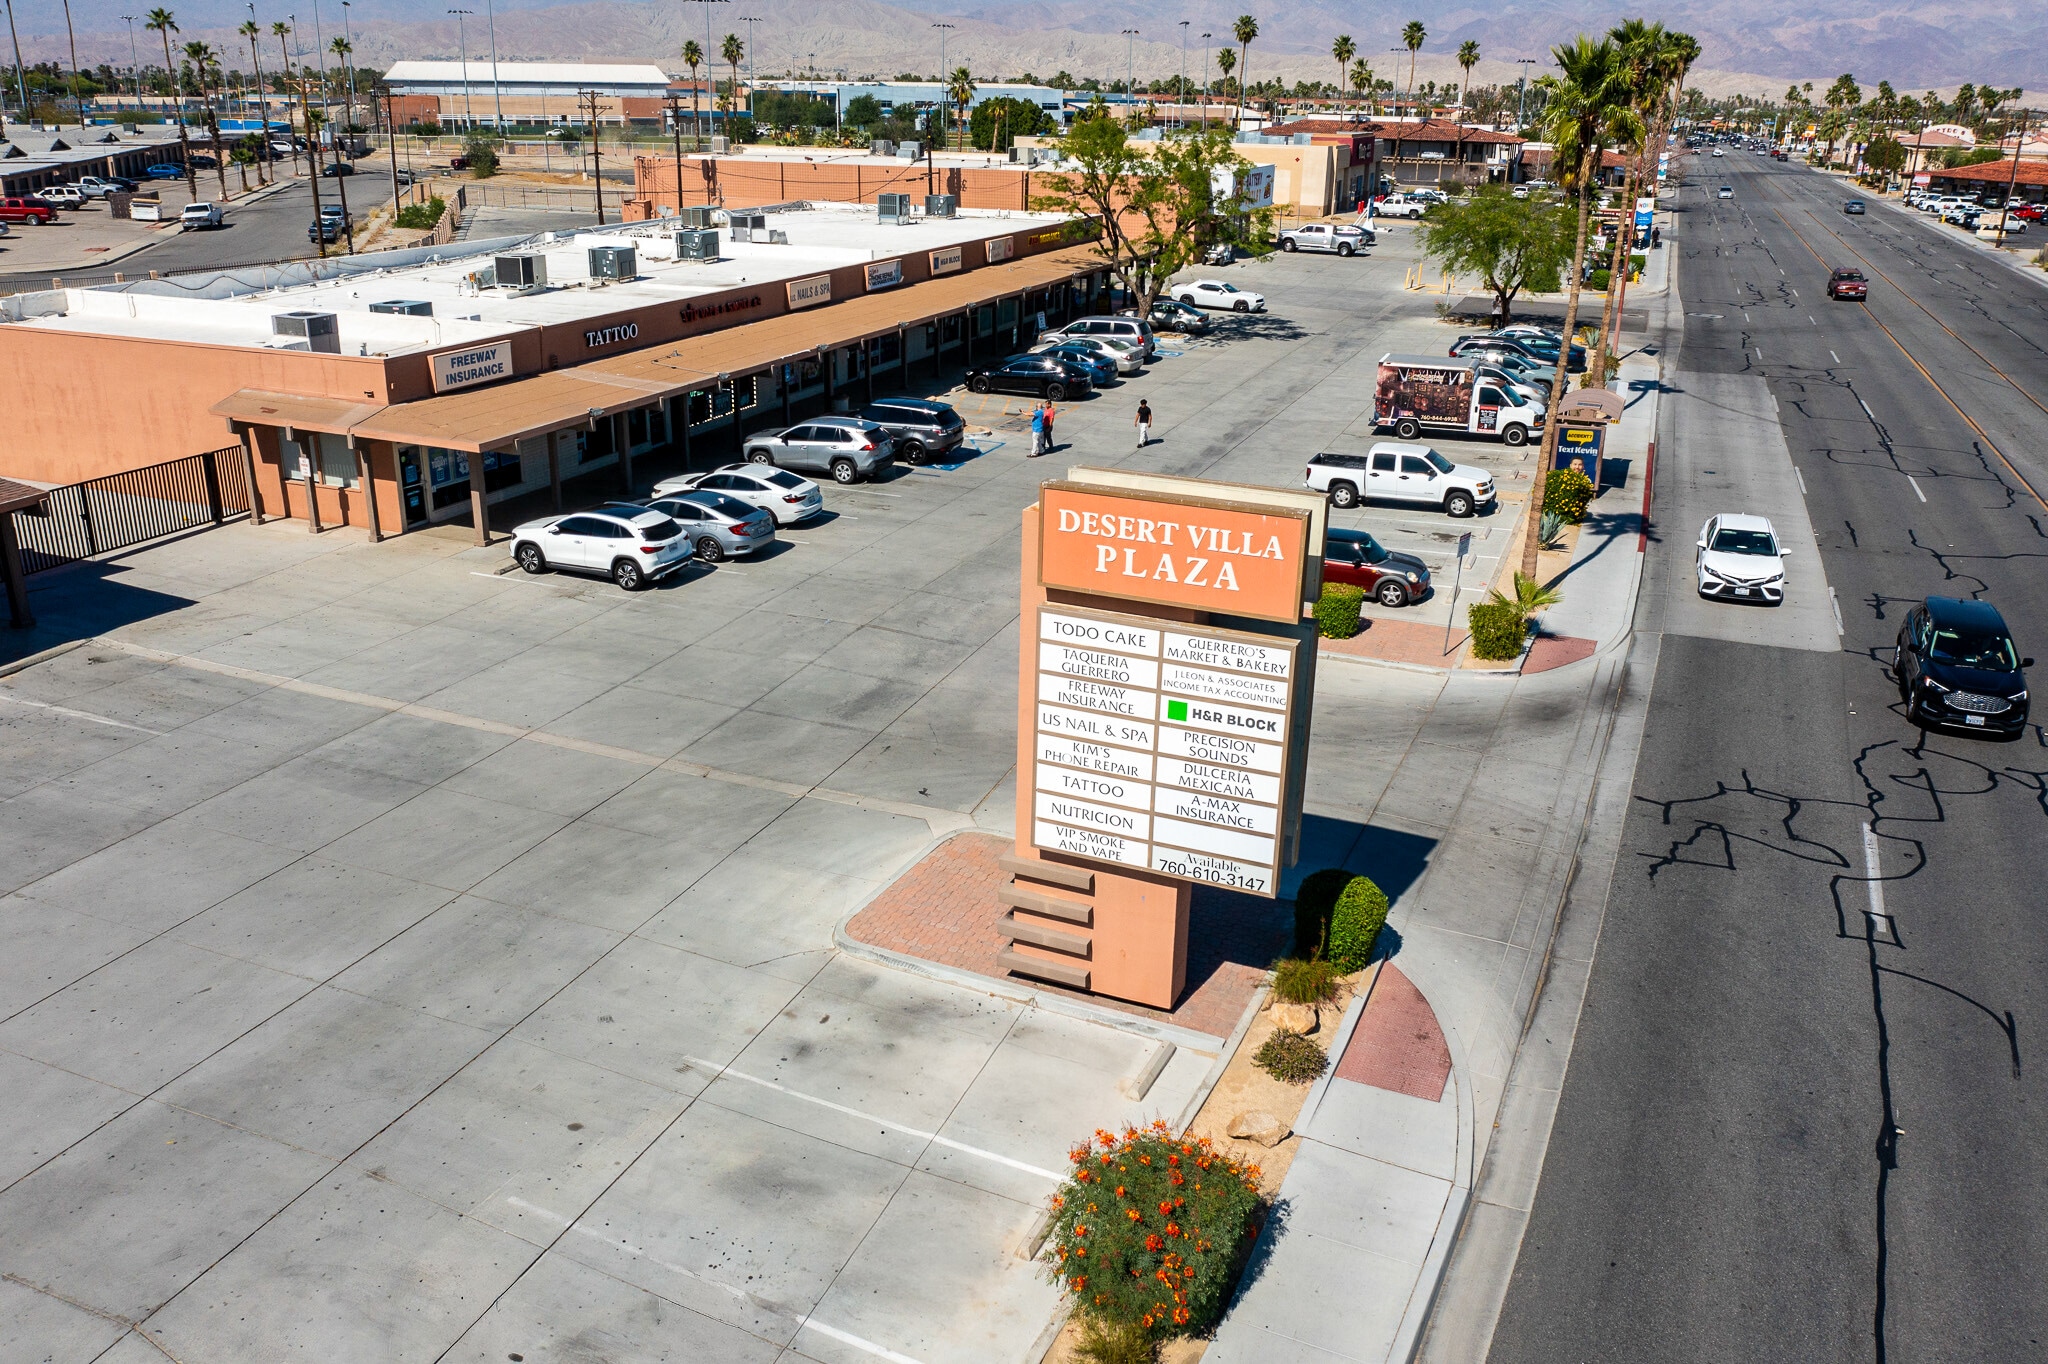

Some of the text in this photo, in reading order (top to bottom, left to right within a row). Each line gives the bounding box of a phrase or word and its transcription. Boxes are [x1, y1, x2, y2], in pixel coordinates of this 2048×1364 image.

[797, 286, 814, 300] NAILS
[814, 285, 819, 297] &
[820, 282, 830, 295] SPA
[586, 323, 639, 348] TATTOO
[450, 349, 497, 369] FREEWAY
[445, 362, 504, 385] INSURANCE
[1558, 445, 1574, 453] Text
[1574, 446, 1598, 455] Kevin
[1058, 508, 1284, 561] DESERT VILLA
[1095, 544, 1240, 591] PLAZA
[1053, 621, 1146, 648] TODO CAKE
[1063, 648, 1129, 669] TAQUERIA
[1187, 638, 1266, 659] GUERRERO'S
[1061, 661, 1130, 682] GUERRERO
[1167, 647, 1287, 674] MARKET & BAKERY
[1068, 680, 1126, 699] FREEWAY
[1163, 679, 1287, 706] INCOME TAX ACCOUNTING
[1180, 670, 1205, 682] LEON
[1207, 675, 1214, 683] &
[1217, 677, 1276, 693] ASSOCIATES
[1058, 691, 1135, 714] INSURANCE
[1042, 712, 1148, 743] US NAIL & SPA
[1192, 708, 1277, 732] H&R BLOCK
[1073, 742, 1111, 758] KIM'S
[1184, 731, 1256, 754] PRECISION
[1045, 749, 1139, 777] PHONE REPAIR
[1188, 746, 1248, 765] SOUNDS
[1062, 775, 1124, 798] TATTOO
[1178, 775, 1255, 799] MEXICANA
[1051, 802, 1133, 830] NUTRICION
[1191, 796, 1240, 813] A-MAX
[1176, 805, 1254, 829] INSURANCE
[1056, 826, 1126, 850] VIP SMOKE
[1059, 839, 1122, 861] AND VAPE
[1159, 858, 1265, 891] 760-610-3147
[1184, 853, 1241, 873] Available
